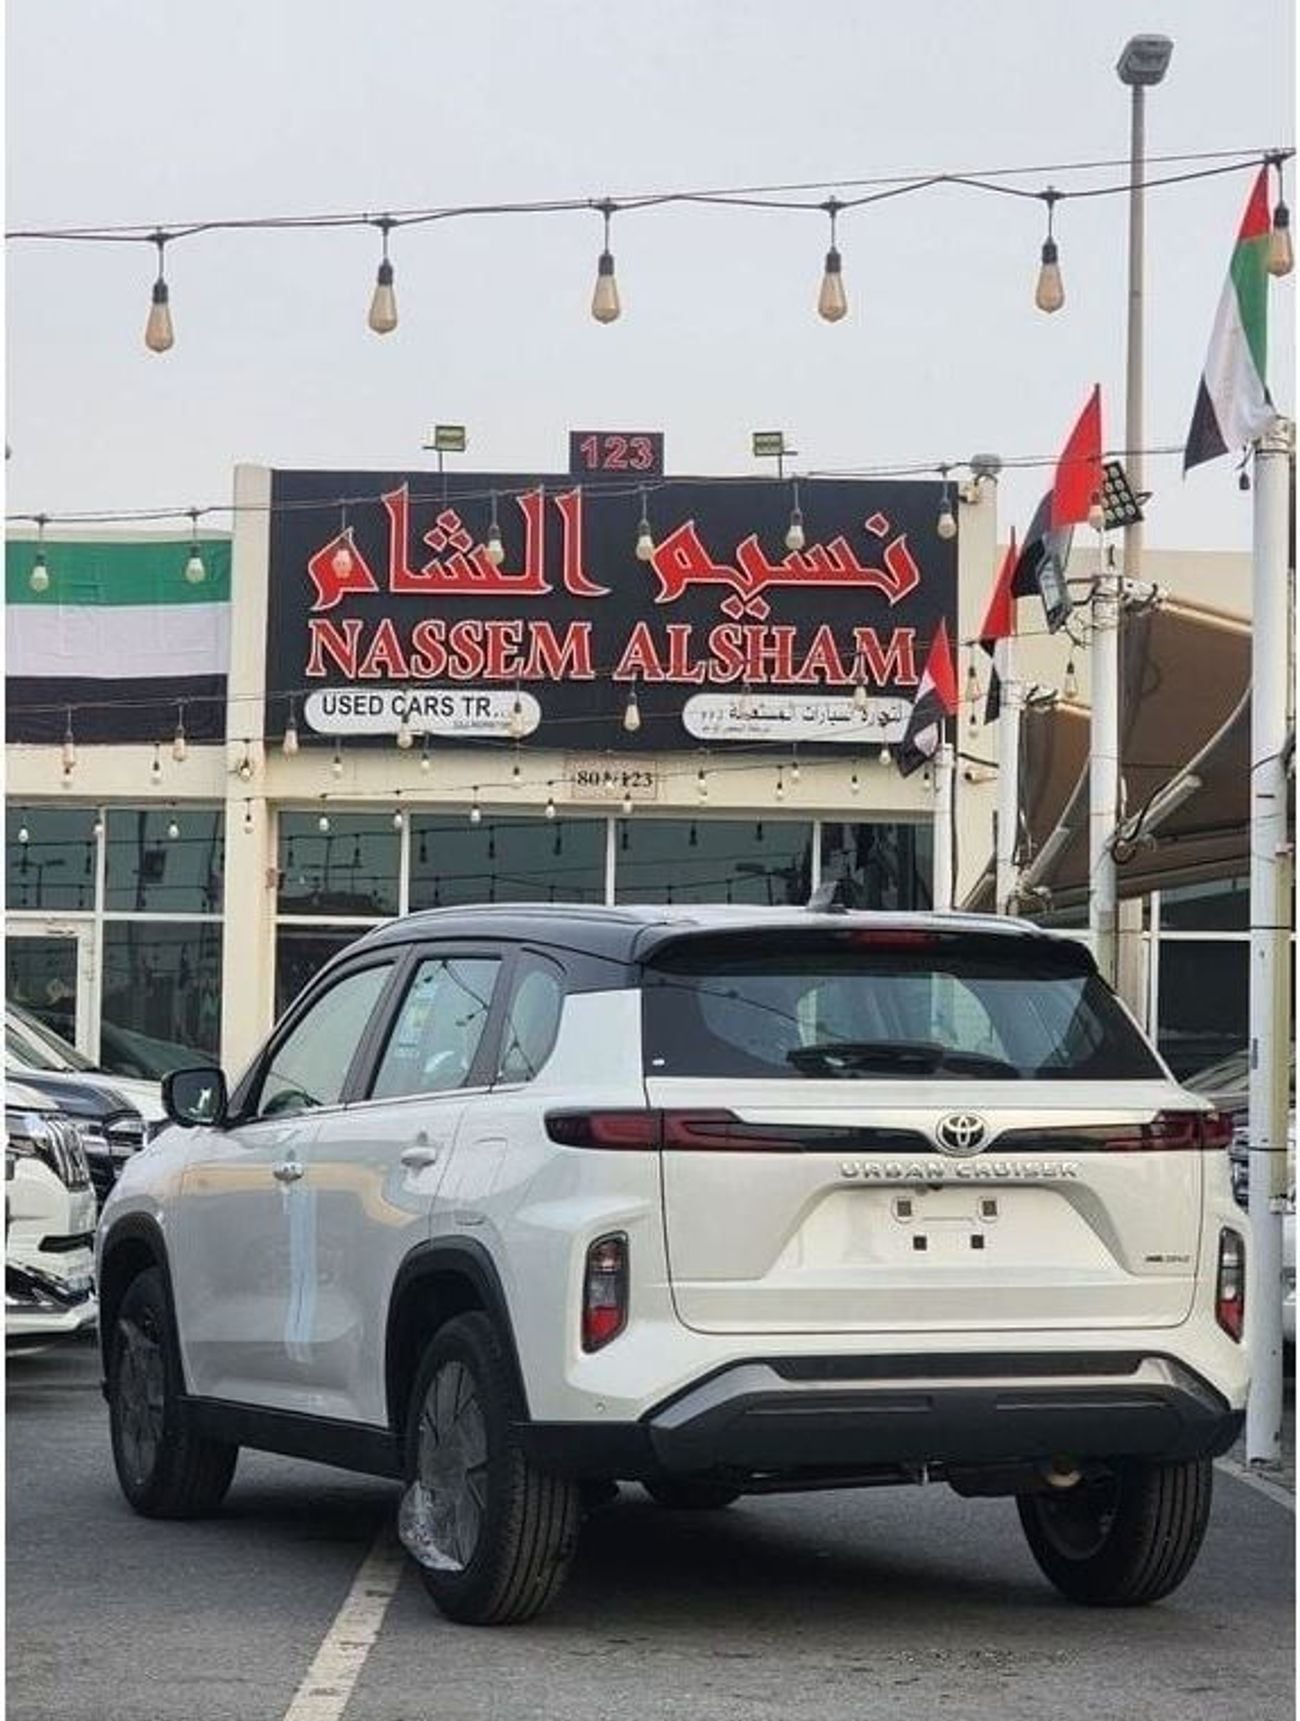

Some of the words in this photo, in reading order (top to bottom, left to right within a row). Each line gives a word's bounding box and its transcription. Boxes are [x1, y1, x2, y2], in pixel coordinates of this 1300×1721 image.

[580, 434, 655, 471] 123
[308, 482, 613, 611] الشام
[653, 511, 920, 620] نسيم
[305, 617, 596, 682] NASSEM
[612, 620, 920, 686] ALSHAM
[322, 694, 384, 716] USED
[391, 694, 455, 717] CARS
[840, 1161, 945, 1179] URBAN
[955, 1161, 1080, 1179] CRUISER
